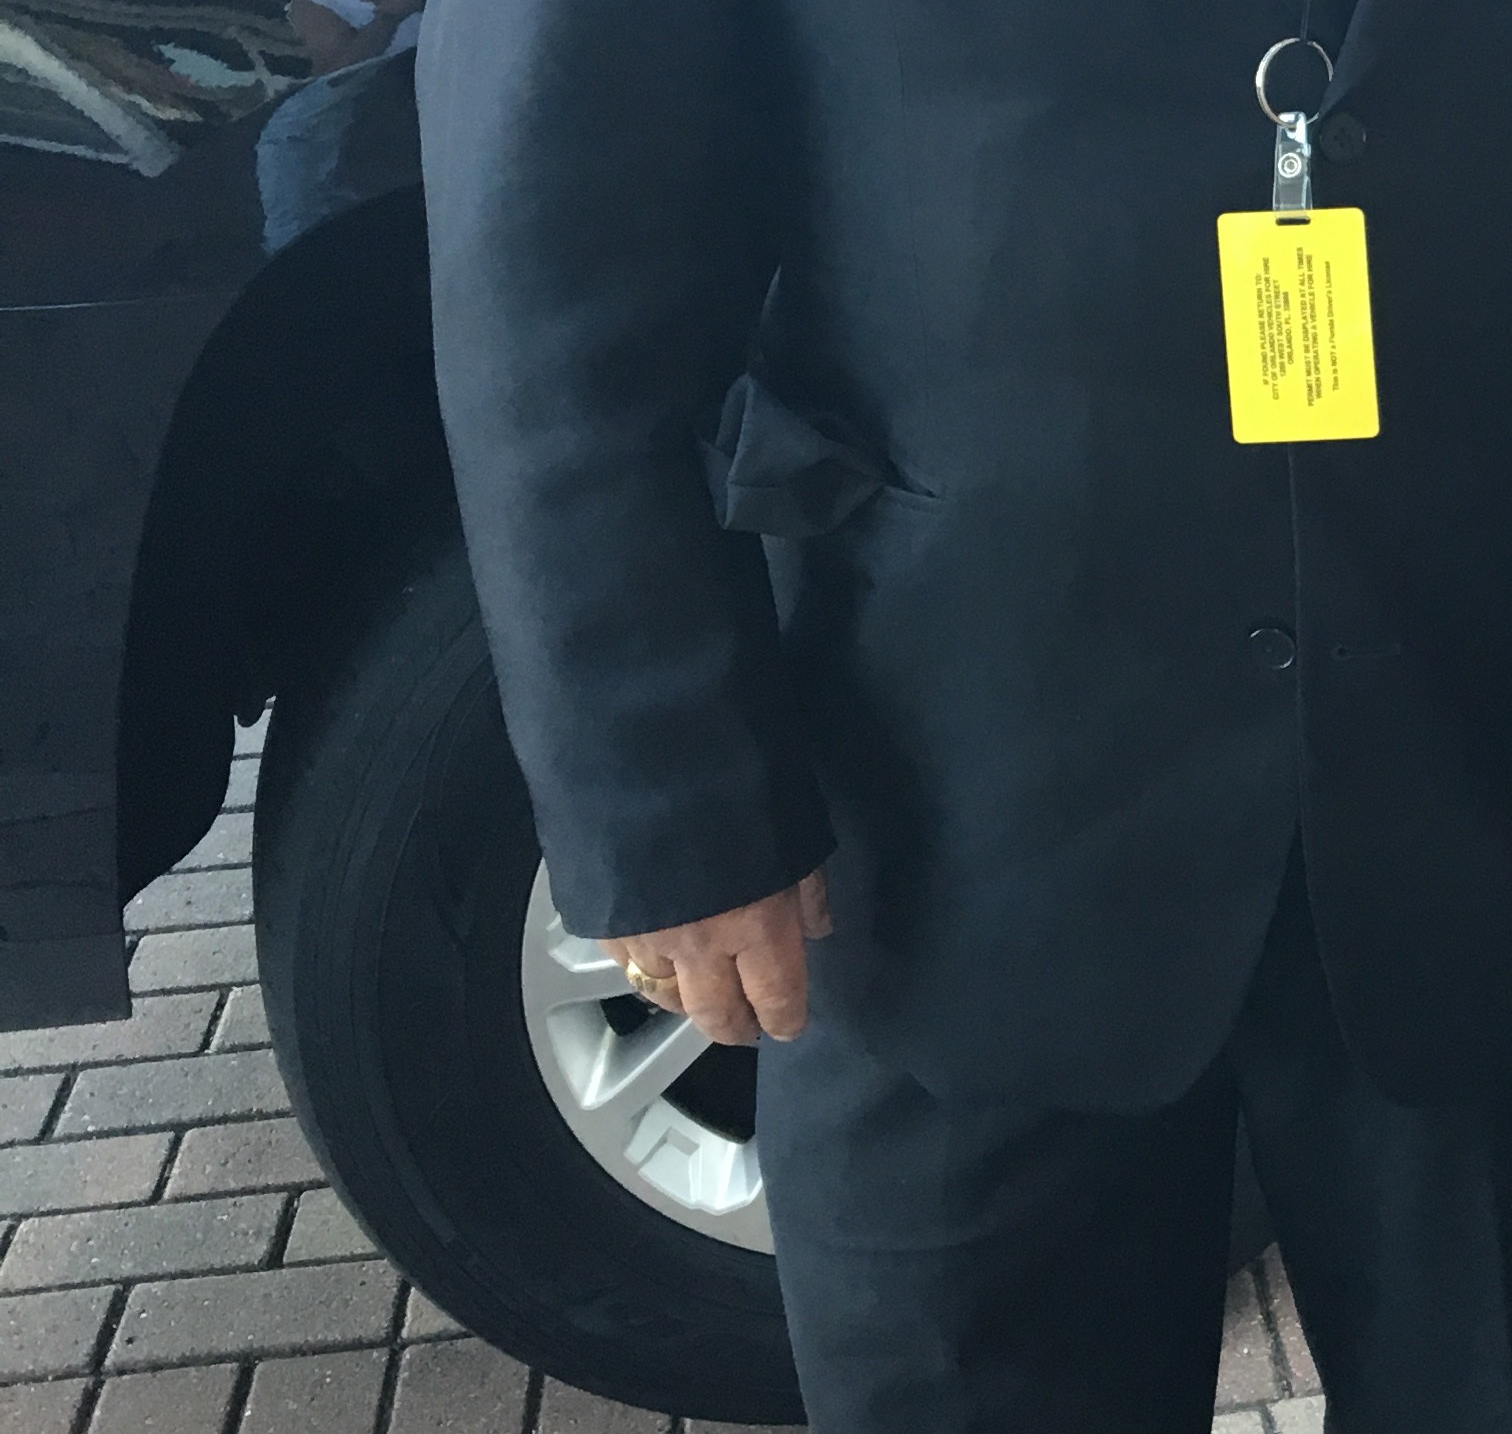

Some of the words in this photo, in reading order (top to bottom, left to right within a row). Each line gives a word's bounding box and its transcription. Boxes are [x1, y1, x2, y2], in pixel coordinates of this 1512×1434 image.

[1262, 257, 1270, 275] HIRE
[1305, 254, 1313, 272] HIRE
[1264, 277, 1272, 292] FOR
[1273, 280, 1281, 309] STREET
[1306, 274, 1314, 290] FOR
[1256, 288, 1265, 318] RETURN
[1265, 294, 1274, 331] VEHICLES
[1308, 291, 1317, 323] VEHICLE
[1275, 311, 1283, 336] SOUTH
[1300, 300, 1310, 342] DISPLAYED
[1328, 319, 1336, 343] Florida
[1258, 320, 1267, 350] PLEASE
[1268, 332, 1277, 369] ORLANDO
[1277, 338, 1285, 360] WEST
[1311, 332, 1321, 375] OPERATING
[1261, 351, 1269, 377] FOUND
[1304, 355, 1312, 377] MUST
[1272, 383, 1280, 400] CITY
[1306, 379, 1315, 406] PERMIT
[1314, 376, 1323, 399] WHEN
